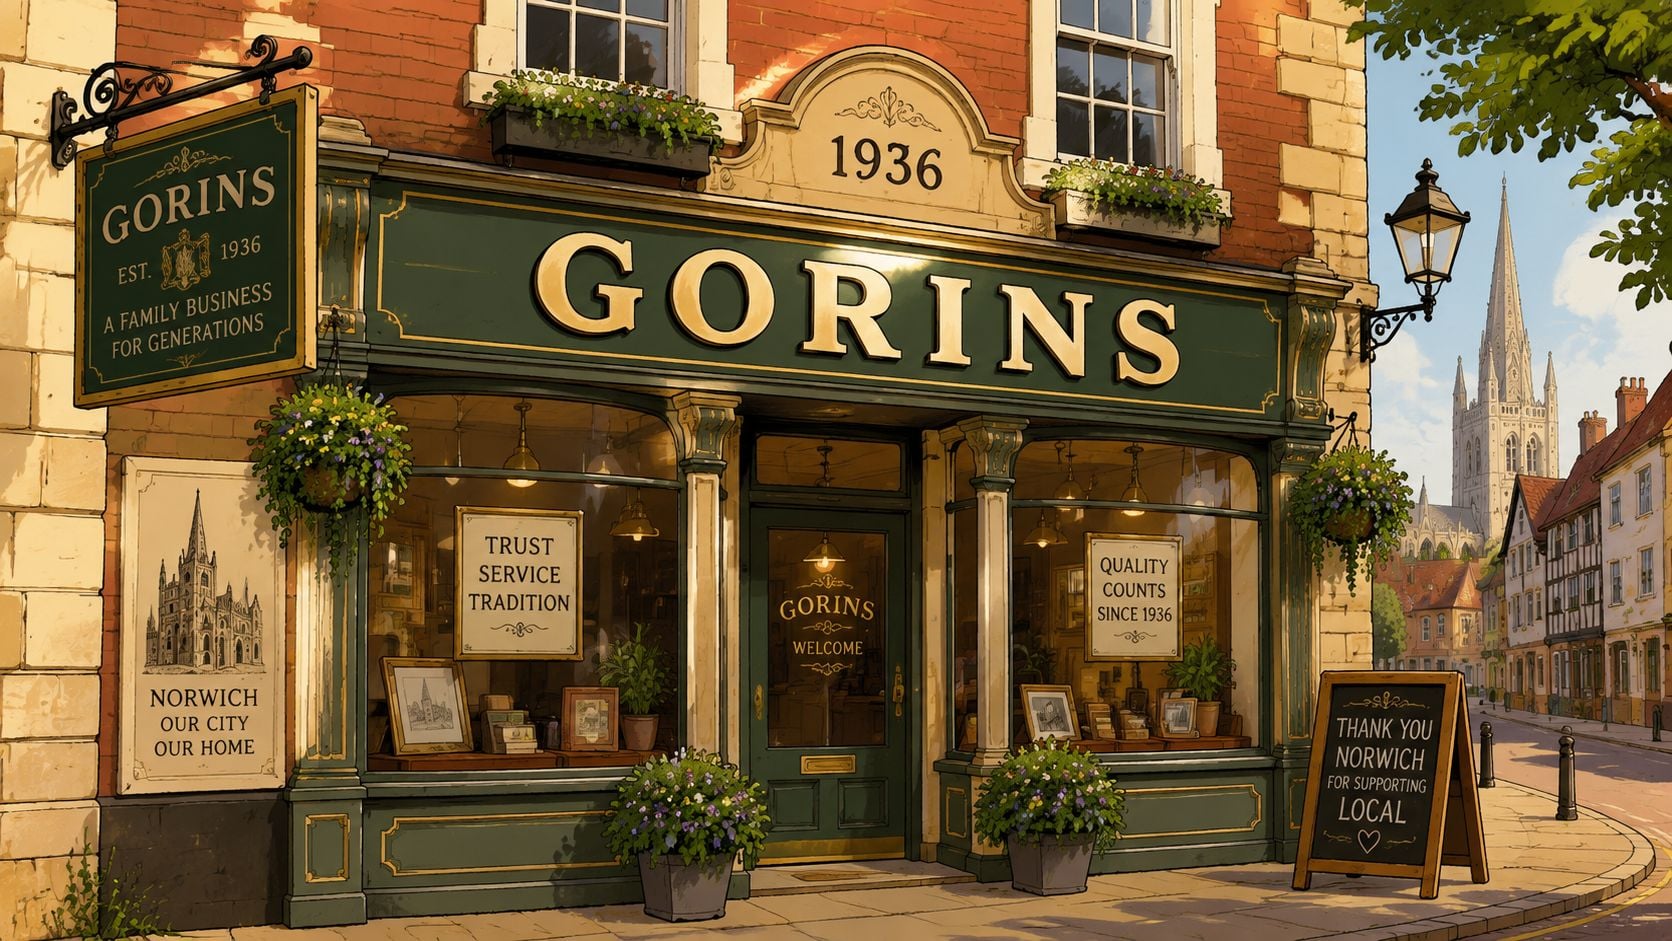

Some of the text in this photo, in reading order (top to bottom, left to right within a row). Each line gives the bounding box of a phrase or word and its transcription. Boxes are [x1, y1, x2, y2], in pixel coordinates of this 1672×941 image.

[831, 135, 943, 191] 1936
[102, 165, 275, 245] GORINS
[117, 235, 261, 285] EST. 1936
[103, 282, 273, 334] A FAMILY BUSINESS
[533, 231, 1181, 386] GORINS
[112, 313, 264, 359] FOR GENERATIONS
[485, 536, 554, 555] TRUST
[479, 564, 561, 584] SERVICE
[1100, 556, 1169, 576] QUALITY
[1102, 582, 1166, 599] COUNTS
[468, 593, 570, 612] TRADITION
[779, 594, 875, 621] GORINS
[1097, 606, 1173, 622] SINCE 1936
[792, 640, 863, 655] WELCOME
[150, 688, 258, 707] NORWICH
[160, 715, 249, 732] OUR CITY
[1336, 717, 1434, 741] THANK YOU
[154, 739, 255, 757] OUR HOME
[1335, 746, 1425, 771] NORWICH
[1327, 775, 1427, 794] FOR SUPPORTING
[1338, 796, 1407, 824] LOCAL
